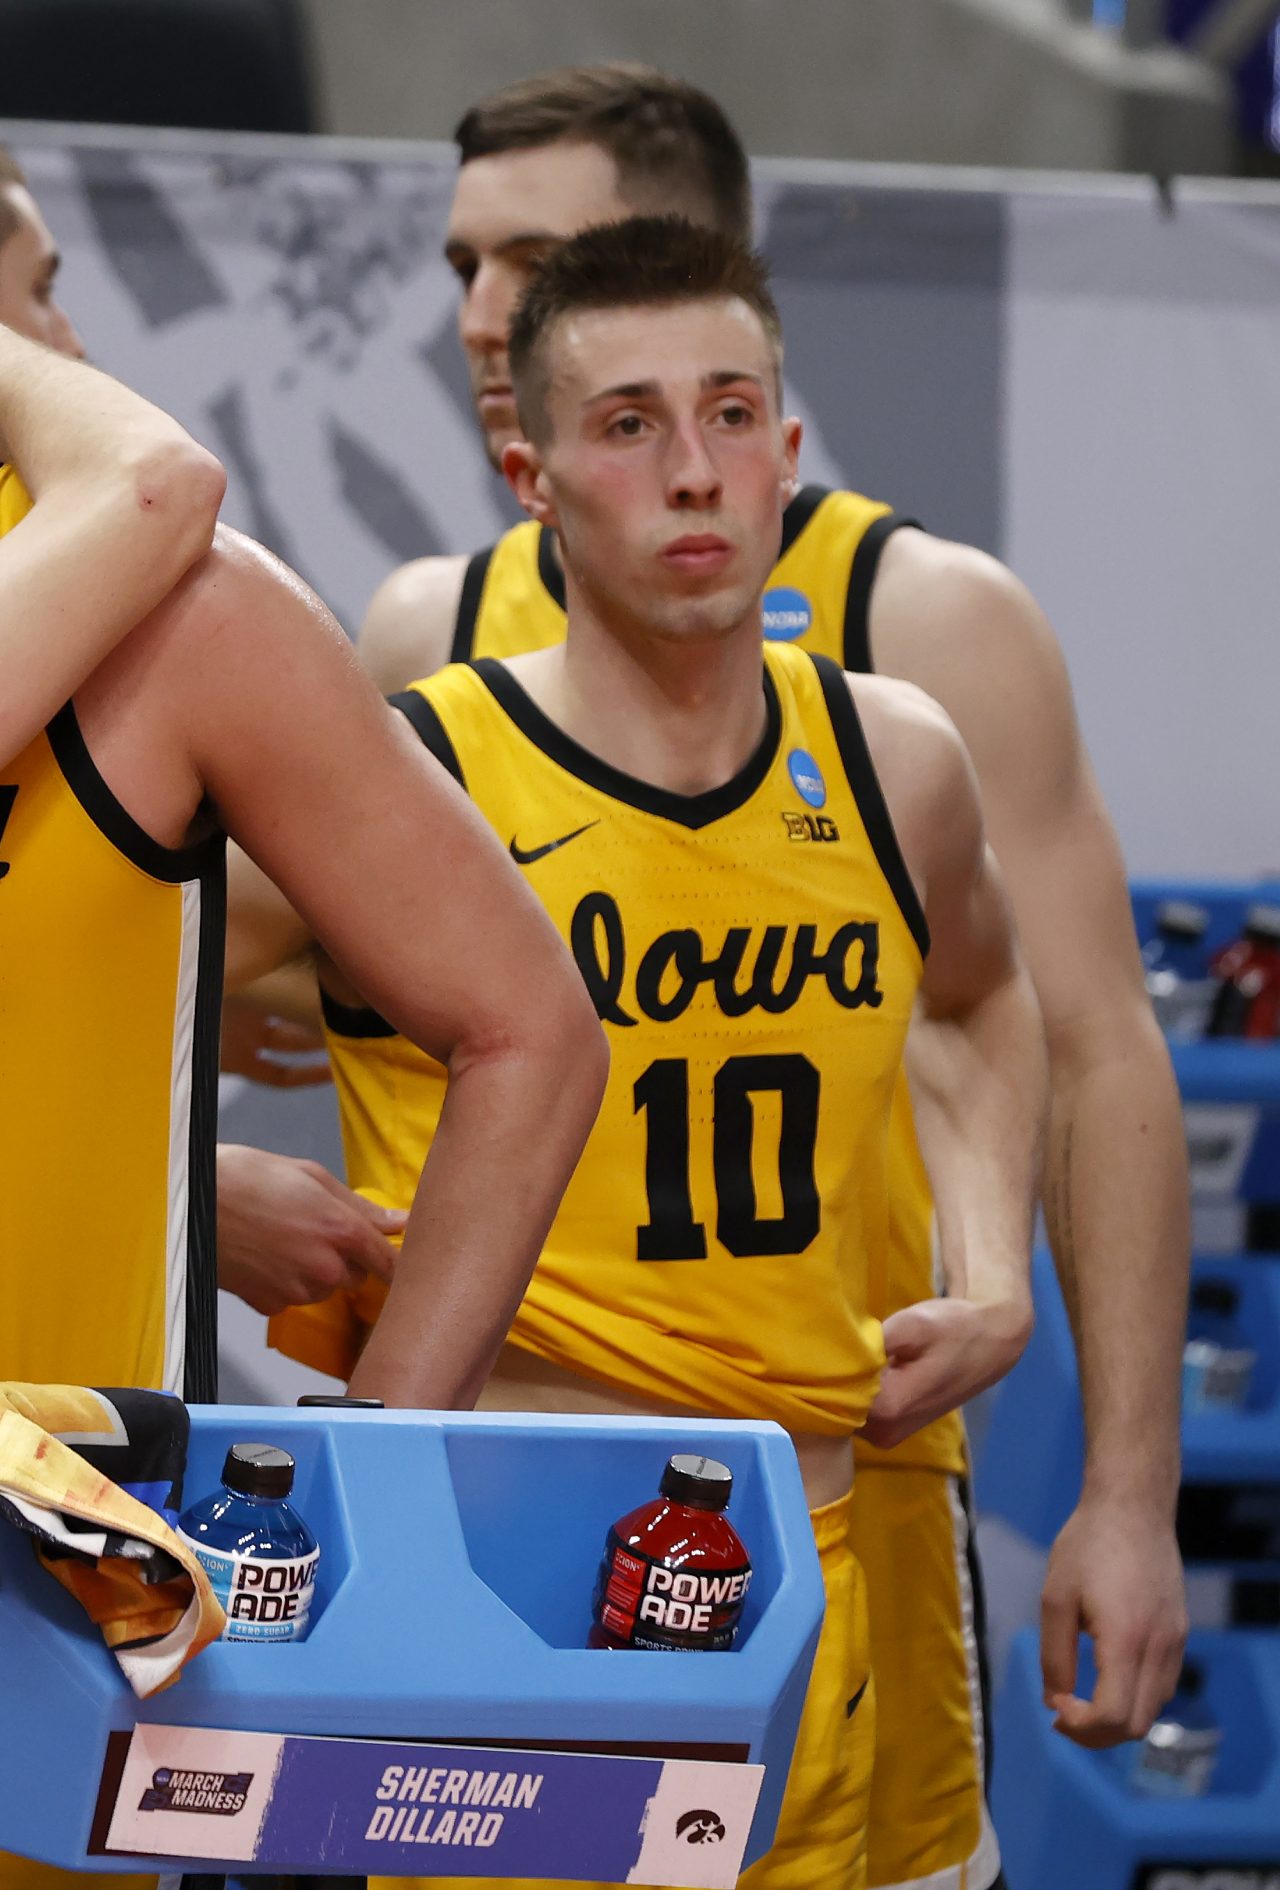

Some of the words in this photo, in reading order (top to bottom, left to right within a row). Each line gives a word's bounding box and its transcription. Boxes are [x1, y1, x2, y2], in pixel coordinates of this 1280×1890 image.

[570, 891, 884, 1027] Iowa
[633, 1053, 821, 1262] 10
[231, 1593, 299, 1622] ADE
[640, 1595, 713, 1632] ADE
[168, 1771, 225, 1792] MARCH
[171, 1789, 246, 1810] MADNESS
[375, 1765, 544, 1809] SHERMAN
[364, 1805, 505, 1847] DILLARD
